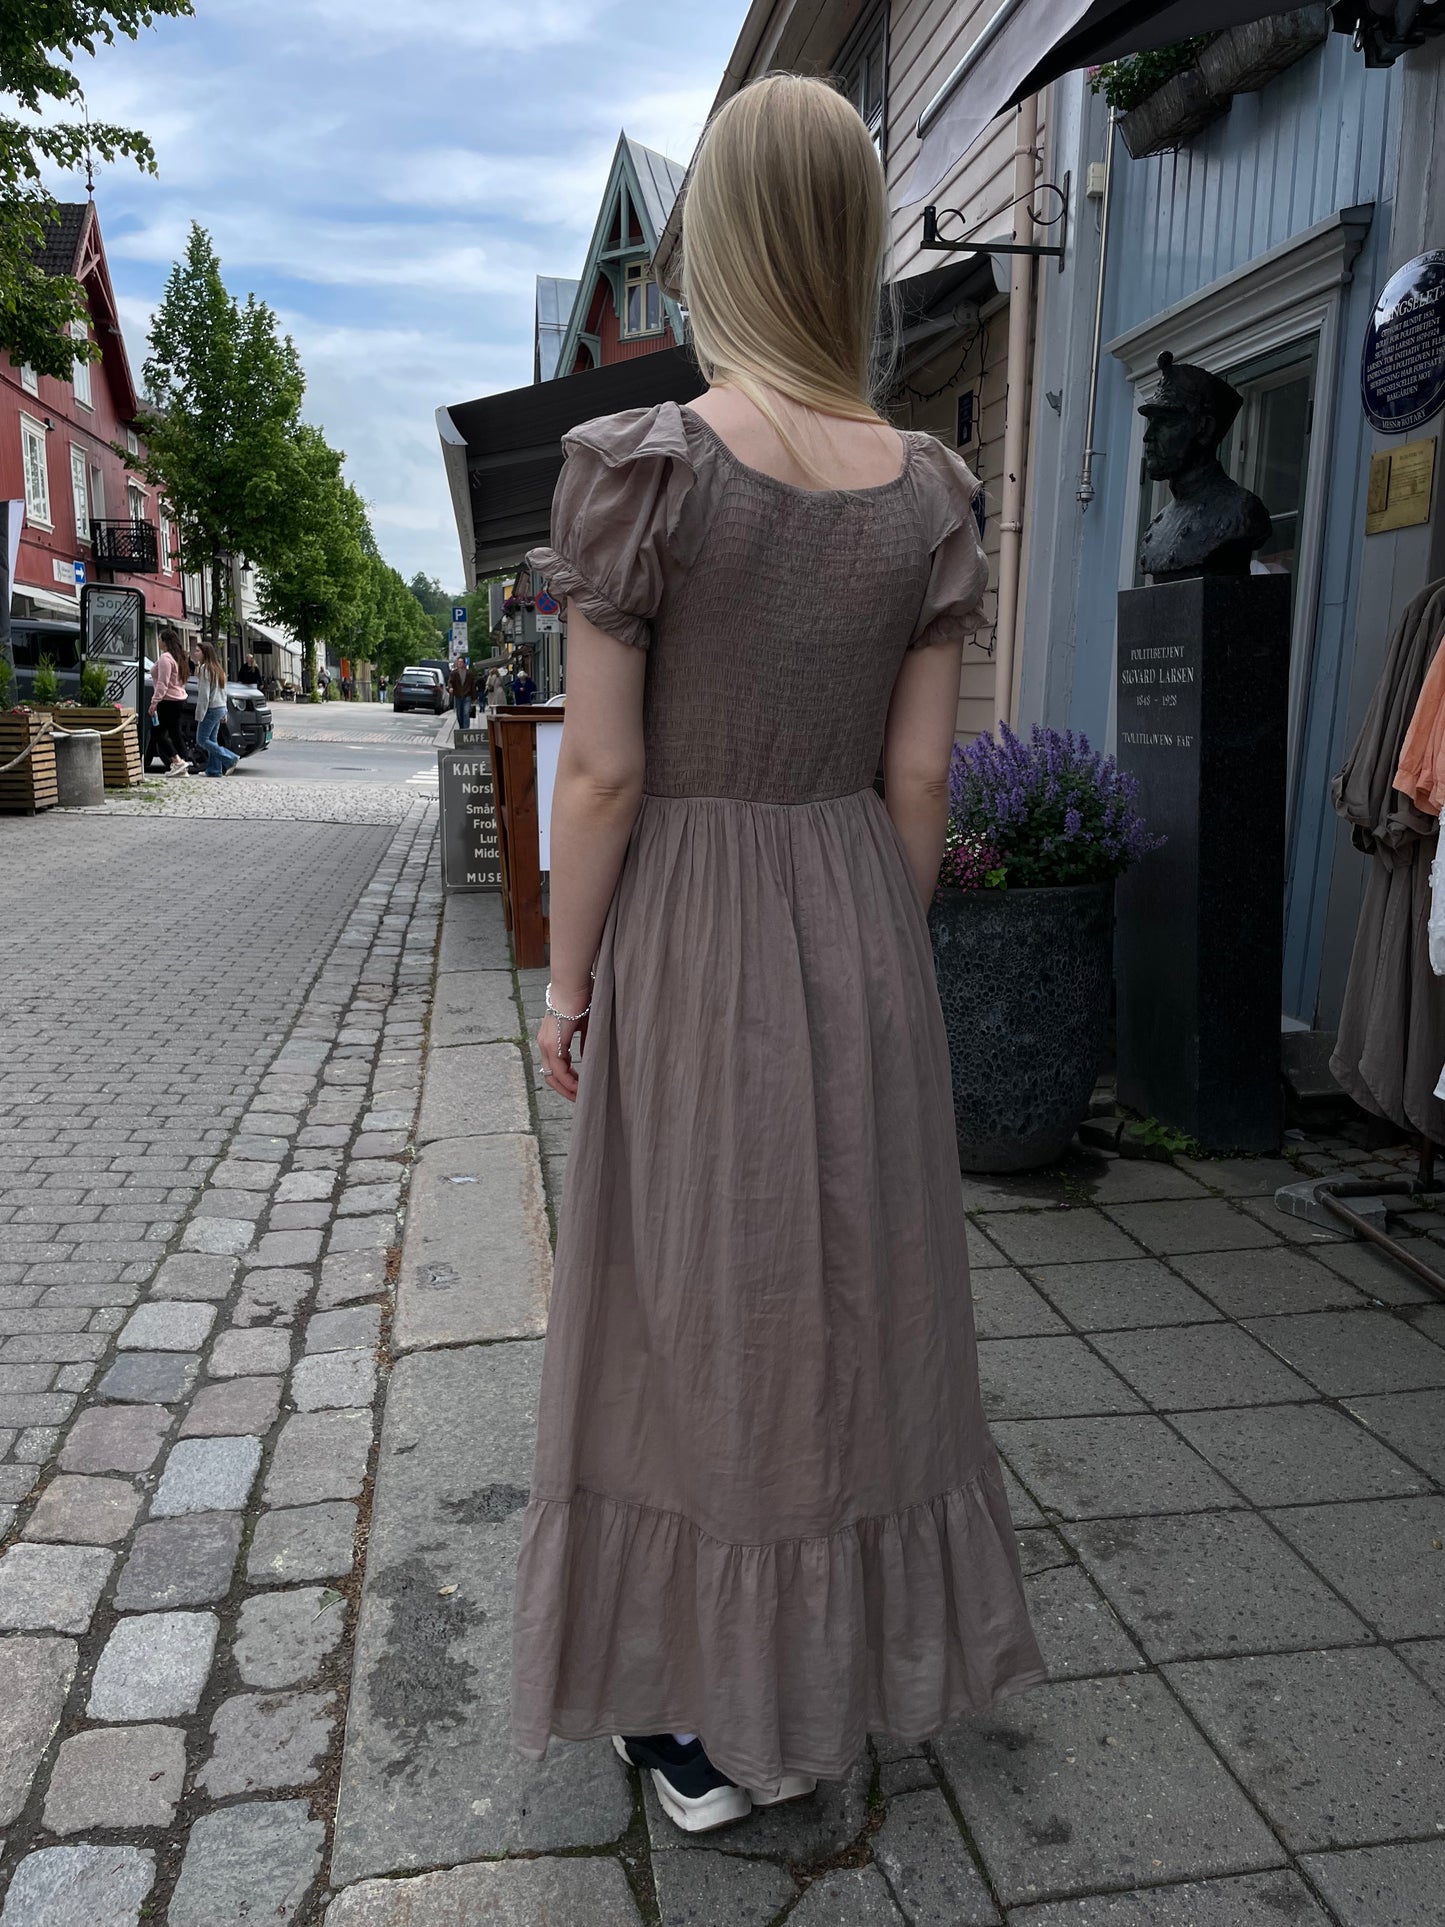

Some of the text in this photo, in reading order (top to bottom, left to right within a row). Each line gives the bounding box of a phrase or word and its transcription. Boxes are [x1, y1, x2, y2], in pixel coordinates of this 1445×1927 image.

[1394, 343, 1420, 360] INITIATIV
[1422, 340, 1430, 350] TIL
[1413, 355, 1442, 373] FORTSATT
[1401, 409, 1426, 427] ROTARY
[455, 609, 464, 620] P
[1130, 646, 1185, 660] POLITIBETJENT
[1122, 667, 1194, 685] SIGVARD LARSEN
[463, 731, 486, 743] KAFÉ
[453, 761, 488, 776] KAFÉ
